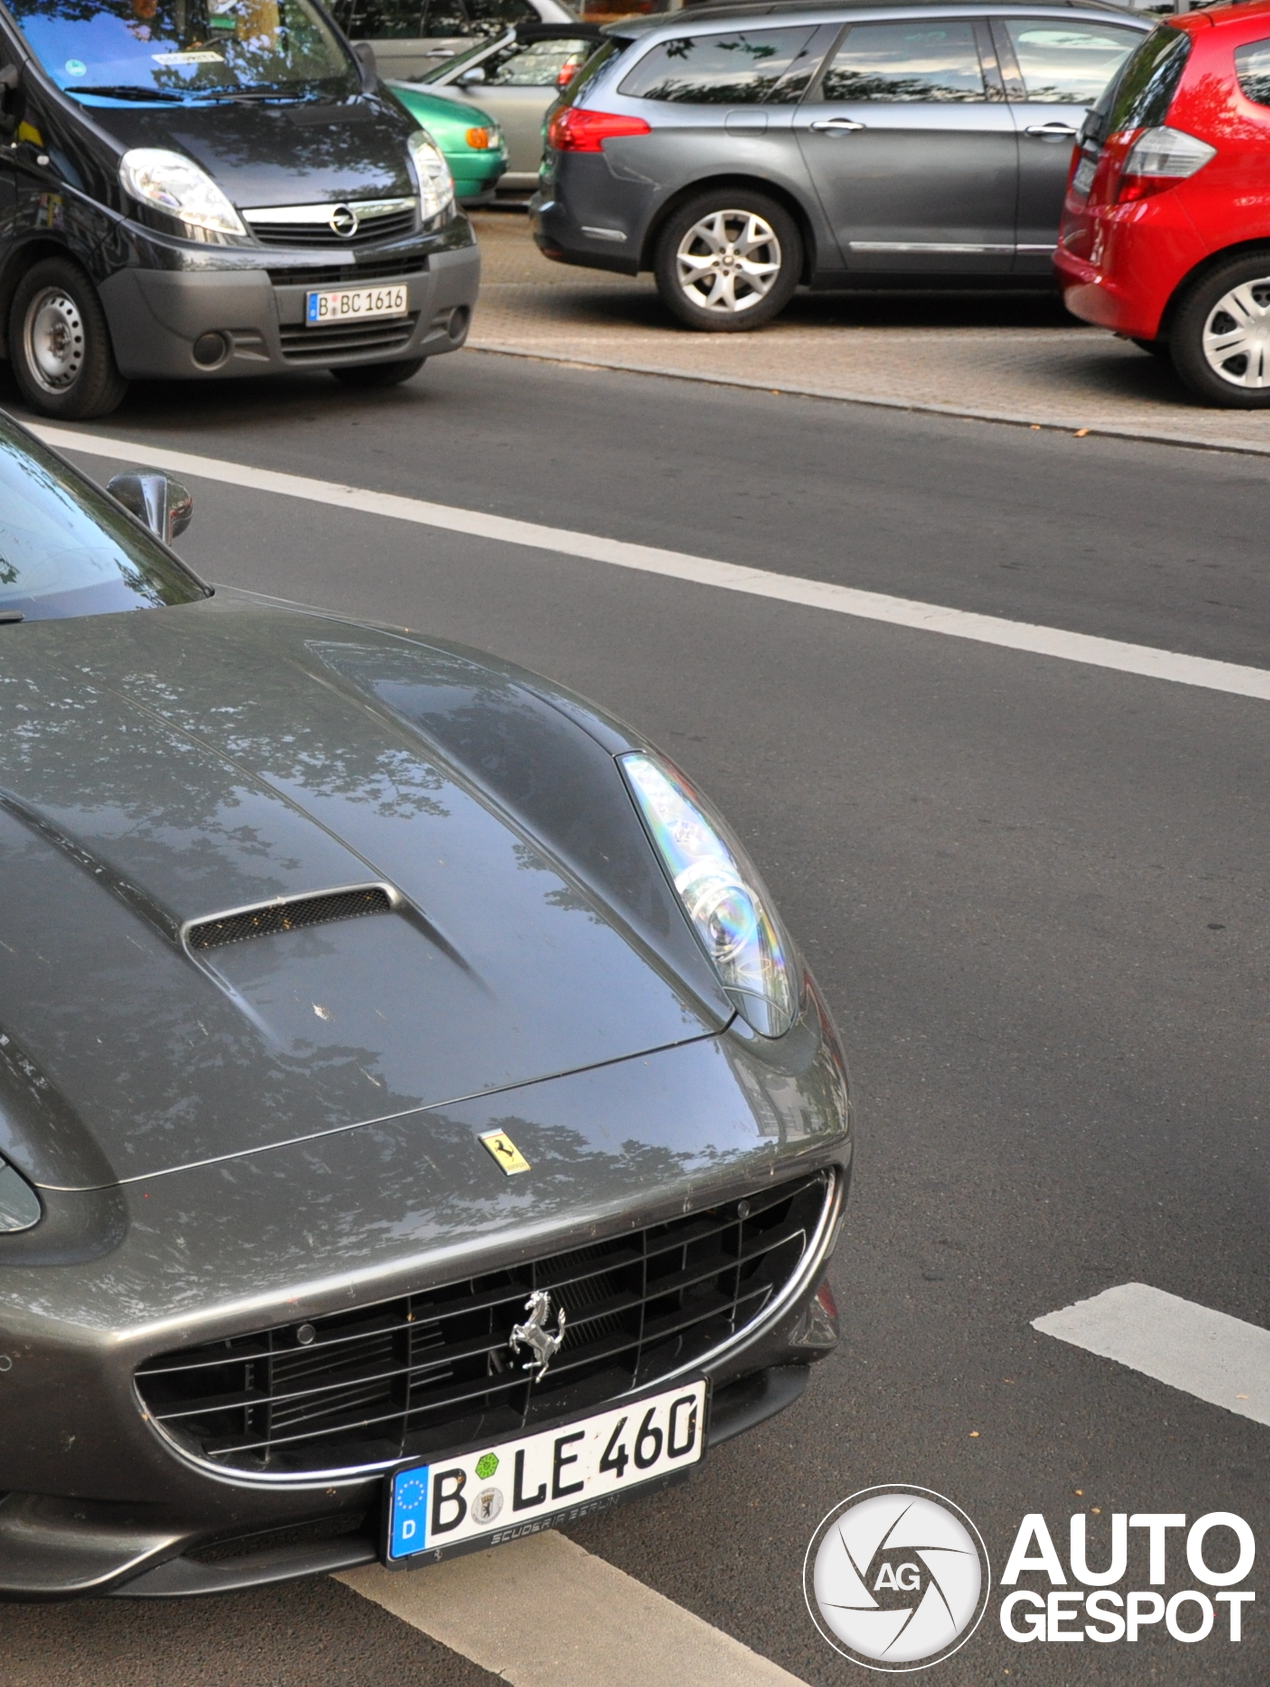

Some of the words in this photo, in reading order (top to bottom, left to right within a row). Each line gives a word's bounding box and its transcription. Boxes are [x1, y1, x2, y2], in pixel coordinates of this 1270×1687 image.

[319, 297, 328, 316] B
[340, 293, 361, 314] BC
[365, 289, 403, 312] 1616
[430, 1468, 468, 1536] B
[512, 1429, 585, 1512] LE
[599, 1394, 697, 1478] 460
[402, 1520, 416, 1540] D
[490, 1513, 566, 1545] SCUDERIA
[569, 1494, 620, 1521] BERLIN
